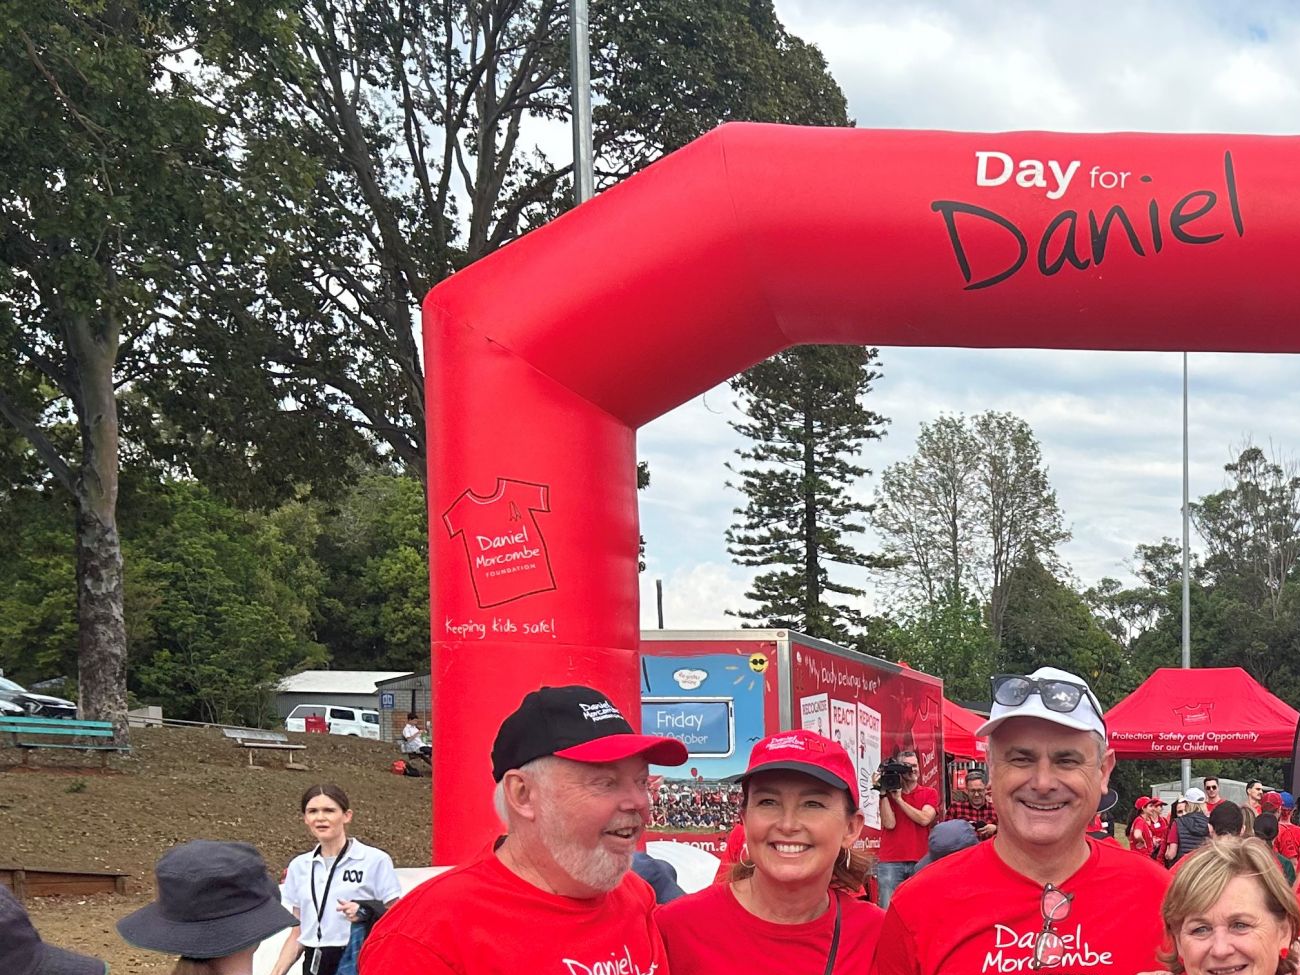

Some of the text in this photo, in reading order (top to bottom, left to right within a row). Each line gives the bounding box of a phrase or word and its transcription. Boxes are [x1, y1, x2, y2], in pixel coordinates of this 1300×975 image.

[975, 151, 1131, 200] Day for
[931, 150, 1244, 290] Daniel
[476, 525, 528, 551] Daniel
[476, 546, 540, 569] Morcombe
[486, 563, 536, 578] FOUNDATION
[445, 615, 557, 640] Keeping kids safe!
[657, 711, 703, 731] Friday
[833, 706, 855, 727] REACT
[859, 709, 880, 733] REPORT
[1112, 732, 1259, 743] Protection Safety and Opportunity
[1151, 741, 1164, 751] for
[1183, 742, 1218, 751] Children
